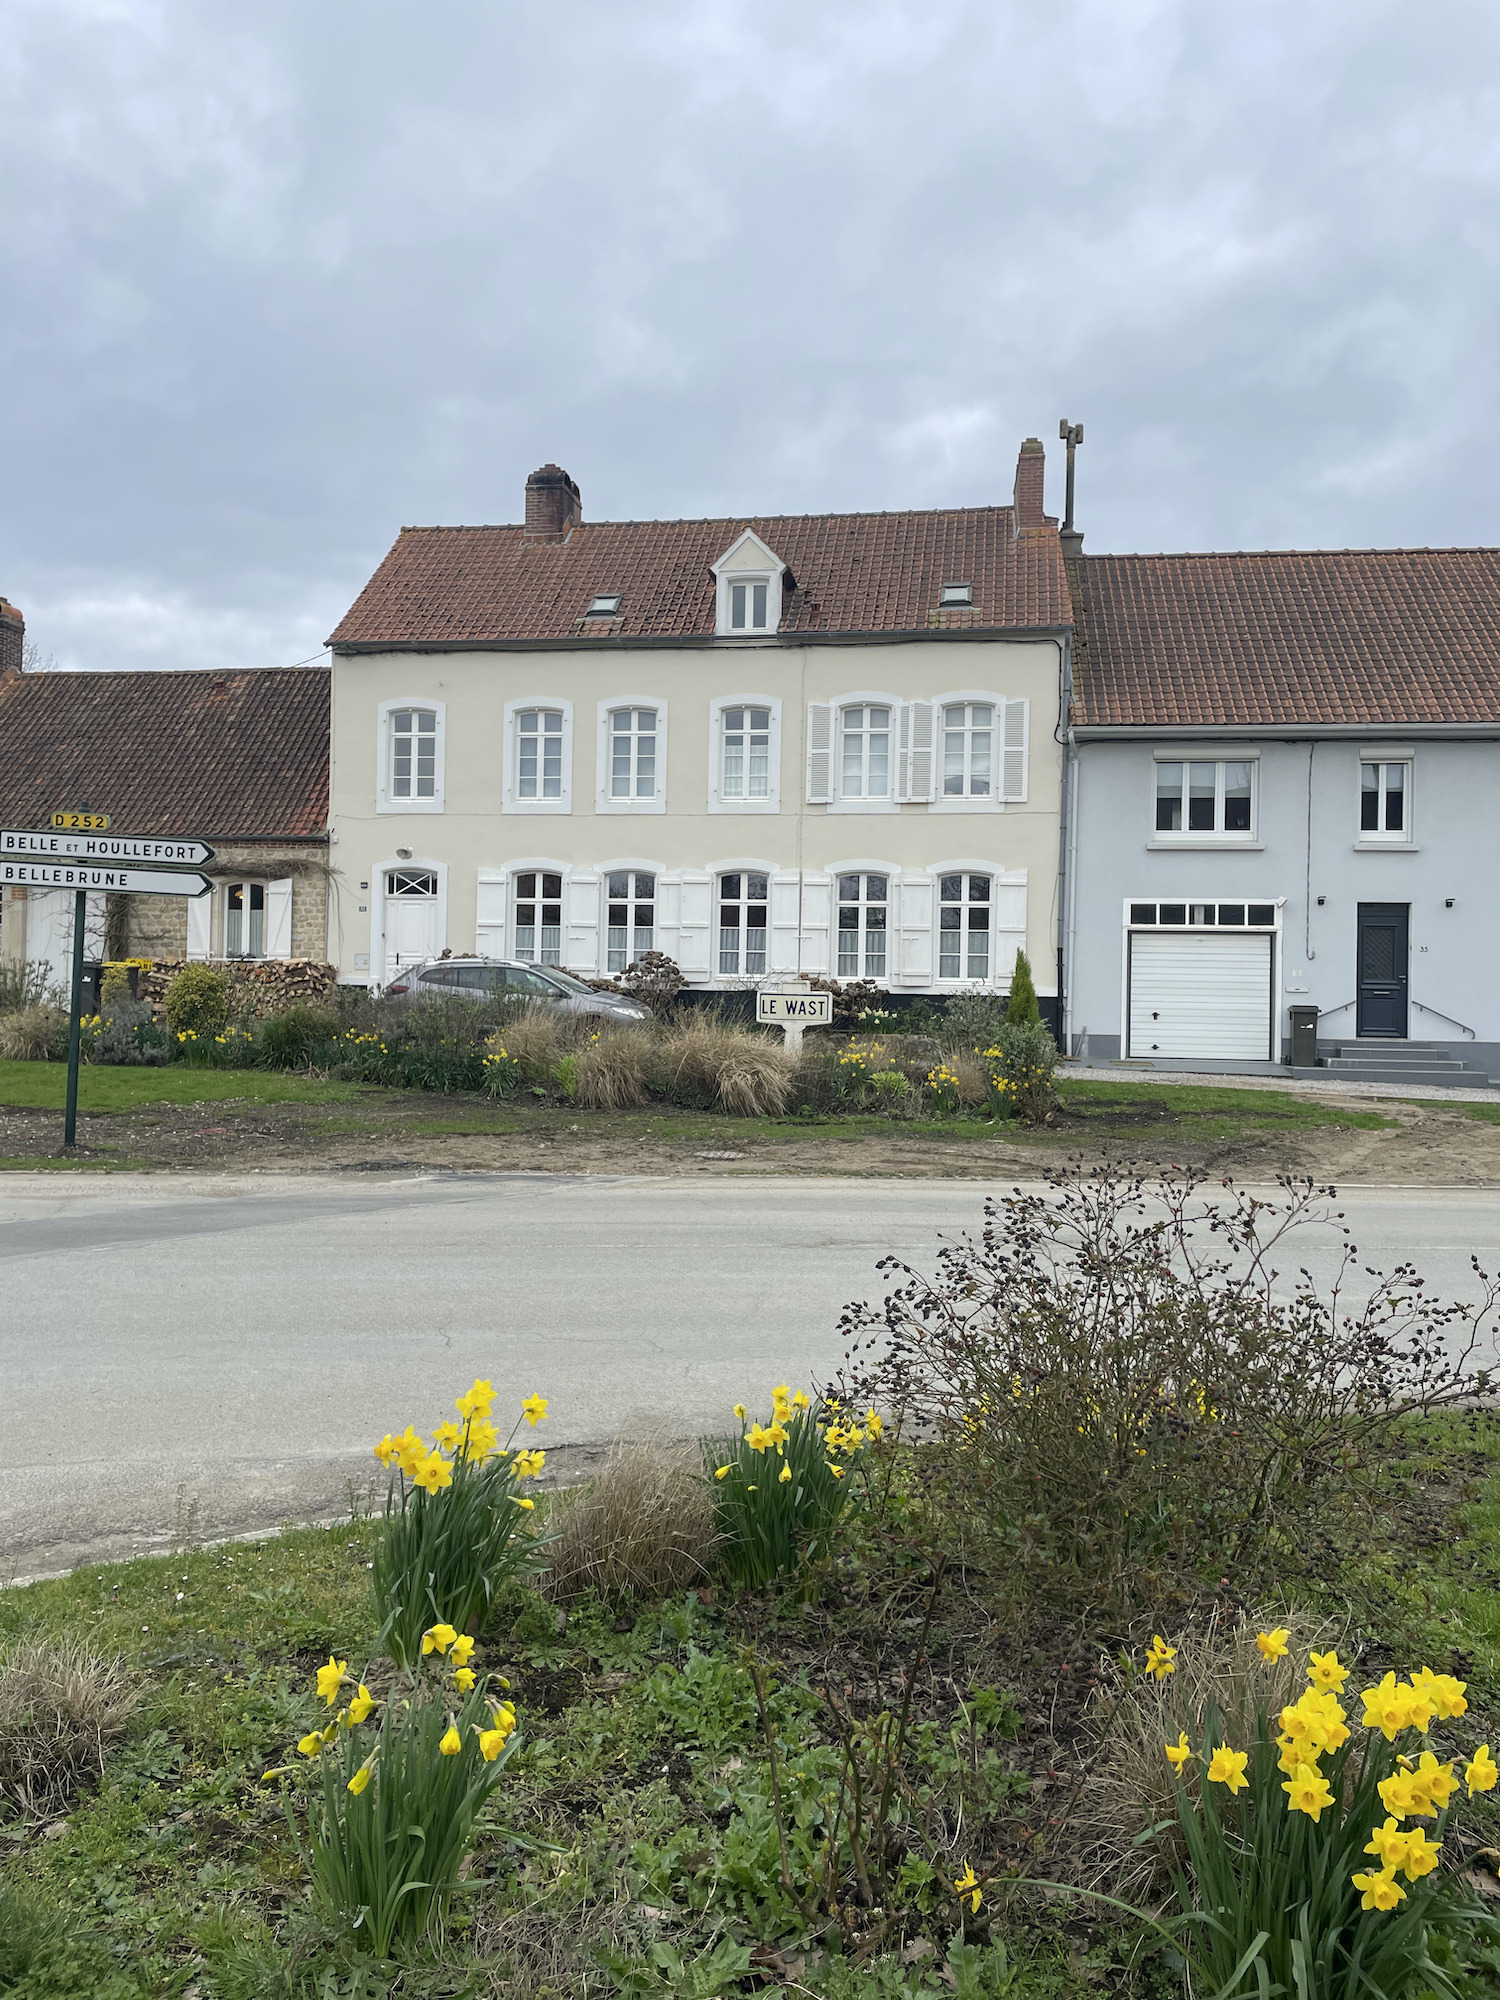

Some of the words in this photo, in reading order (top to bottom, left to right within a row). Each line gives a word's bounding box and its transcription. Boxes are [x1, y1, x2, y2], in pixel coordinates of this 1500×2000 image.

[55, 815, 64, 826] D
[70, 815, 104, 828] 252
[6, 836, 59, 851] BELLE
[66, 843, 79, 852] ET
[86, 841, 196, 859] HOULLEFORT
[5, 867, 128, 886] BELLEBRUNE
[762, 1000, 777, 1014] LE
[785, 1000, 825, 1016] WAST
